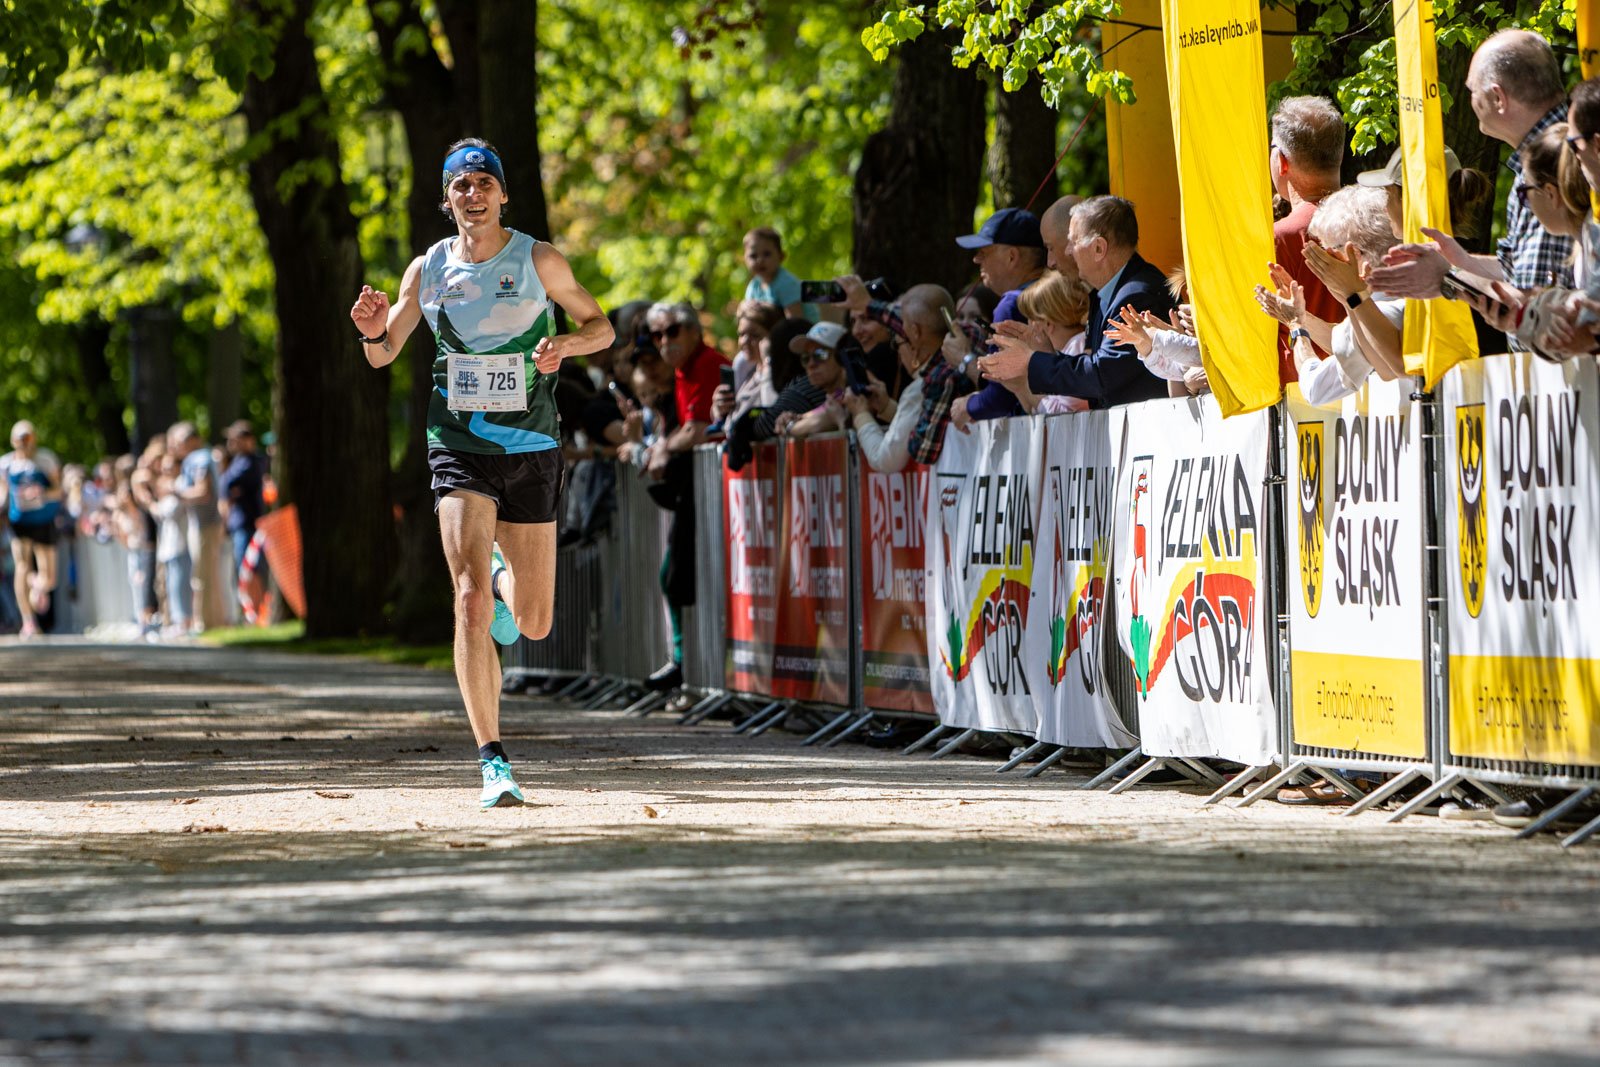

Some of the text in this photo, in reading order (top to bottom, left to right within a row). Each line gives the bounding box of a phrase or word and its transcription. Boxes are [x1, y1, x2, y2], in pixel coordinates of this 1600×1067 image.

[486, 371, 517, 391] 725
[1334, 414, 1405, 503] DOLNY
[1500, 390, 1580, 491] DOLNY
[889, 471, 928, 548] BIK
[963, 473, 1034, 581] JELENIA
[1158, 453, 1258, 577] JELENIA
[1334, 498, 1401, 621] ŚLĄSK
[1501, 486, 1578, 618] ŚLĄSK
[983, 575, 1032, 696] GÓR
[1174, 571, 1253, 705] GÓRA
